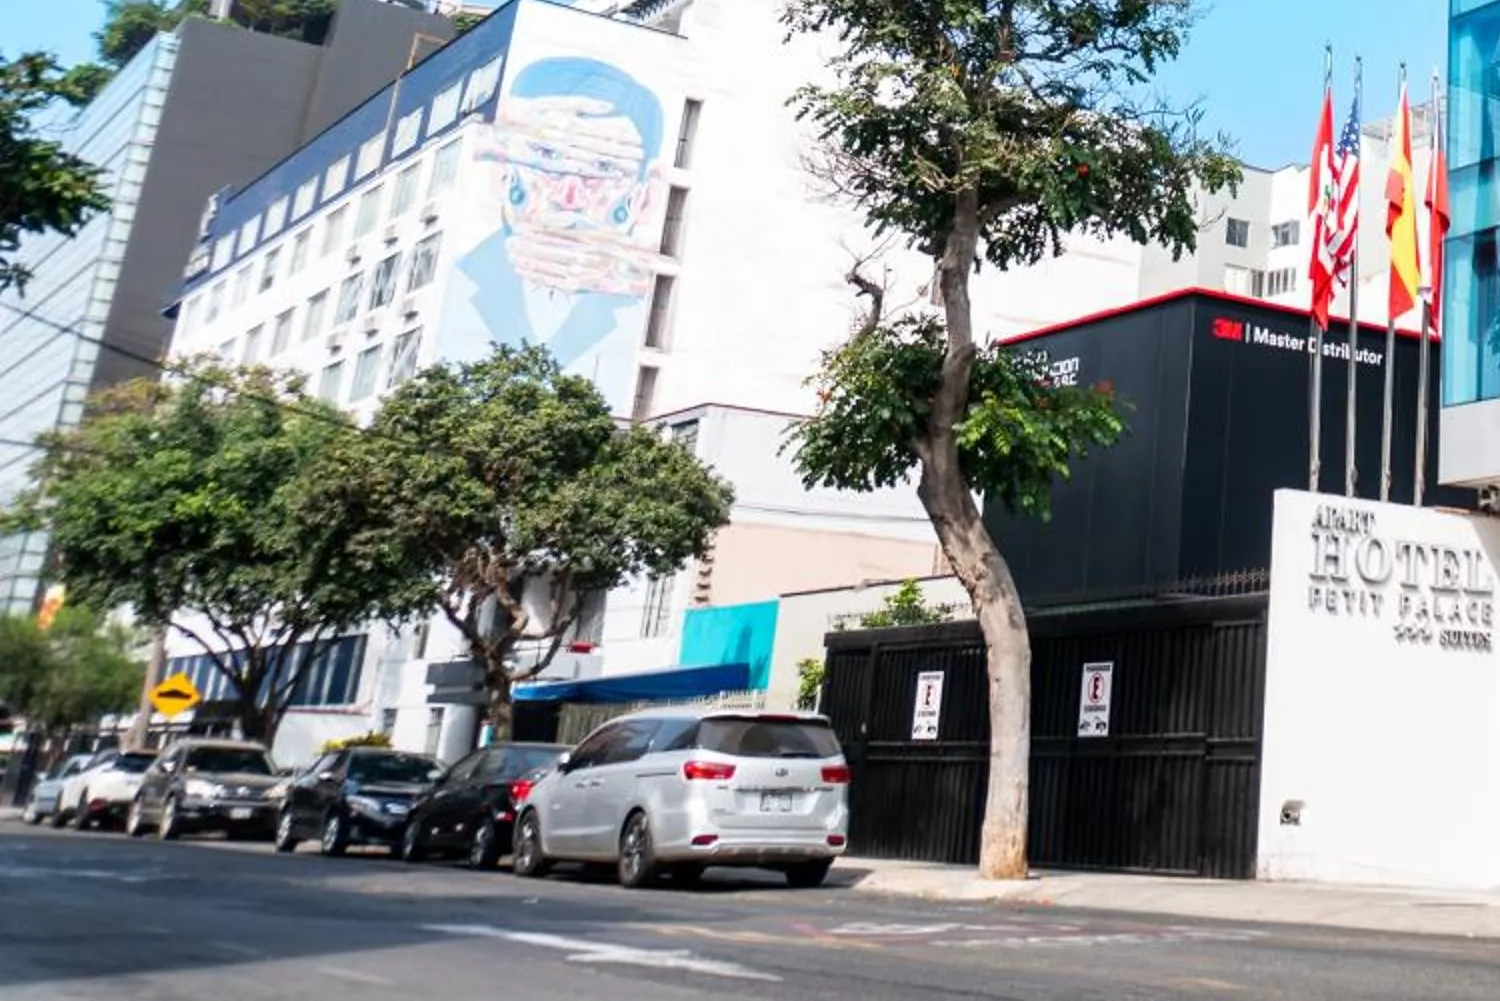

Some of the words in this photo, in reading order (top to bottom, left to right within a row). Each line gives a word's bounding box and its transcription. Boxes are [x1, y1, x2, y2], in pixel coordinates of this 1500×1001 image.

[1253, 327, 1305, 351] Master
[1308, 337, 1383, 365] Dstriutor
[1312, 504, 1376, 534] APART
[1309, 532, 1494, 595] HOTEL
[1309, 586, 1385, 617] PETIT
[1399, 594, 1494, 627] PALACE
